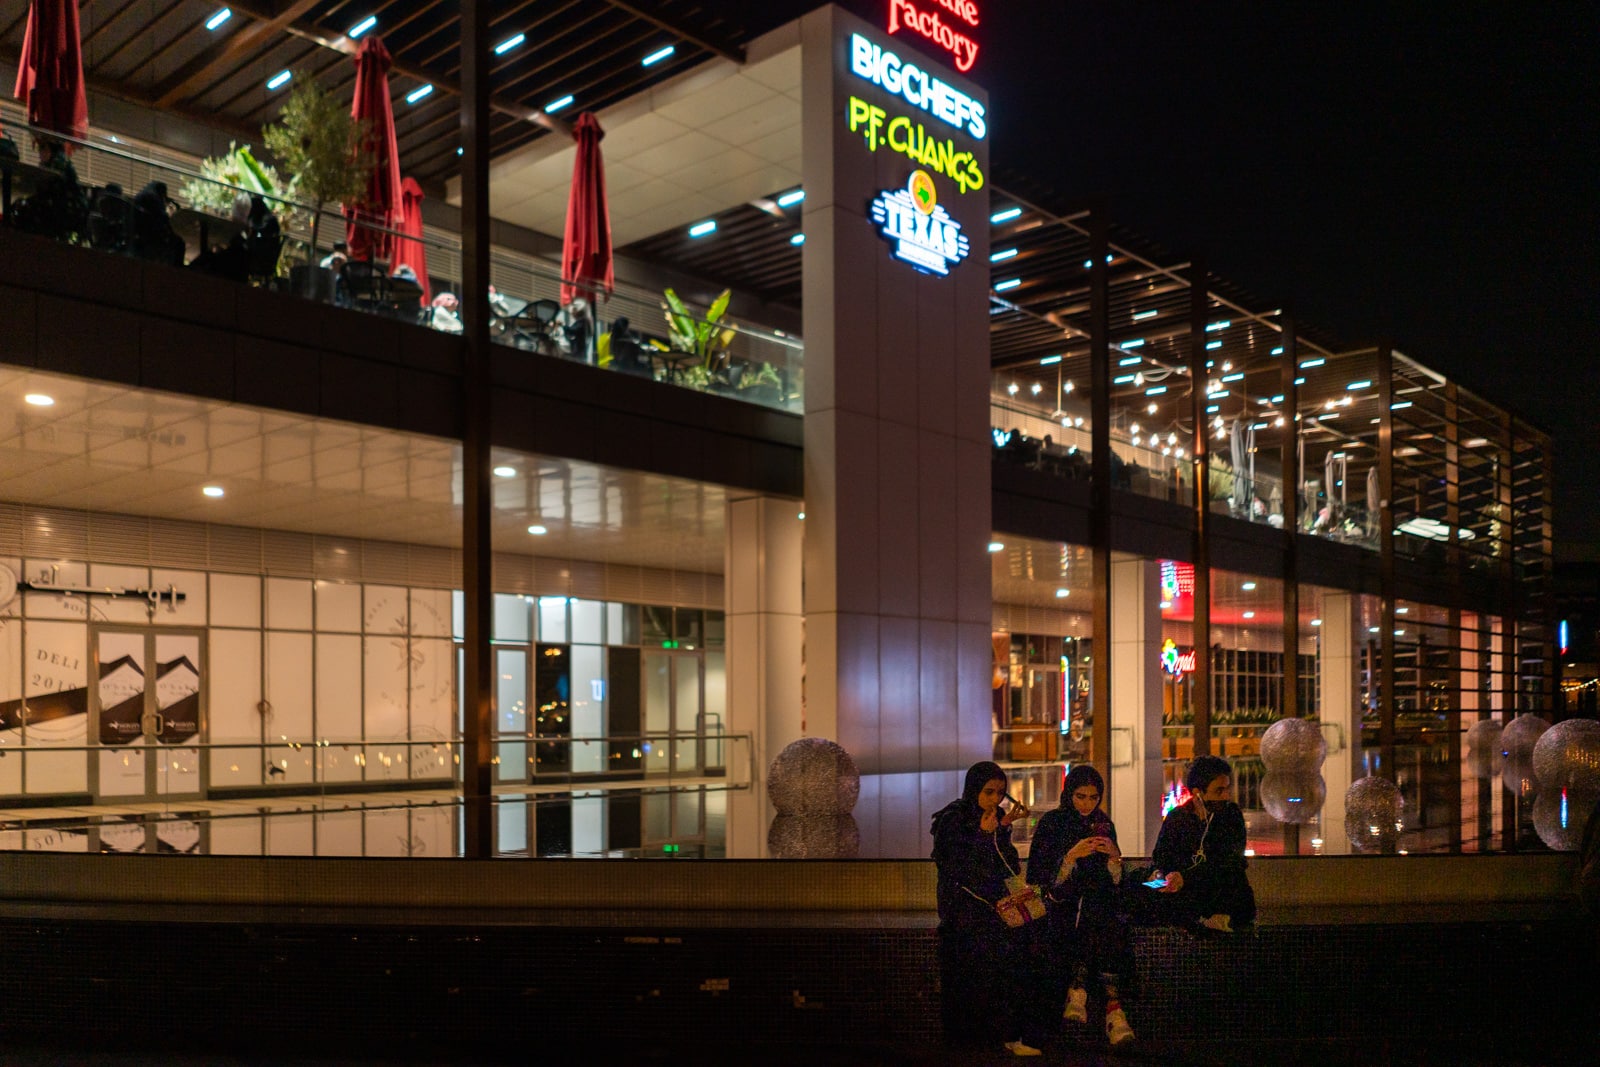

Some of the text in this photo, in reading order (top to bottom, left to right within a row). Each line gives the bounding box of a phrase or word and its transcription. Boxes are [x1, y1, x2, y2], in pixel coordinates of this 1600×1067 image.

[888, 116, 984, 194] CHANG'S
[885, 198, 959, 257] TEXAS
[37, 648, 80, 671] DELI
